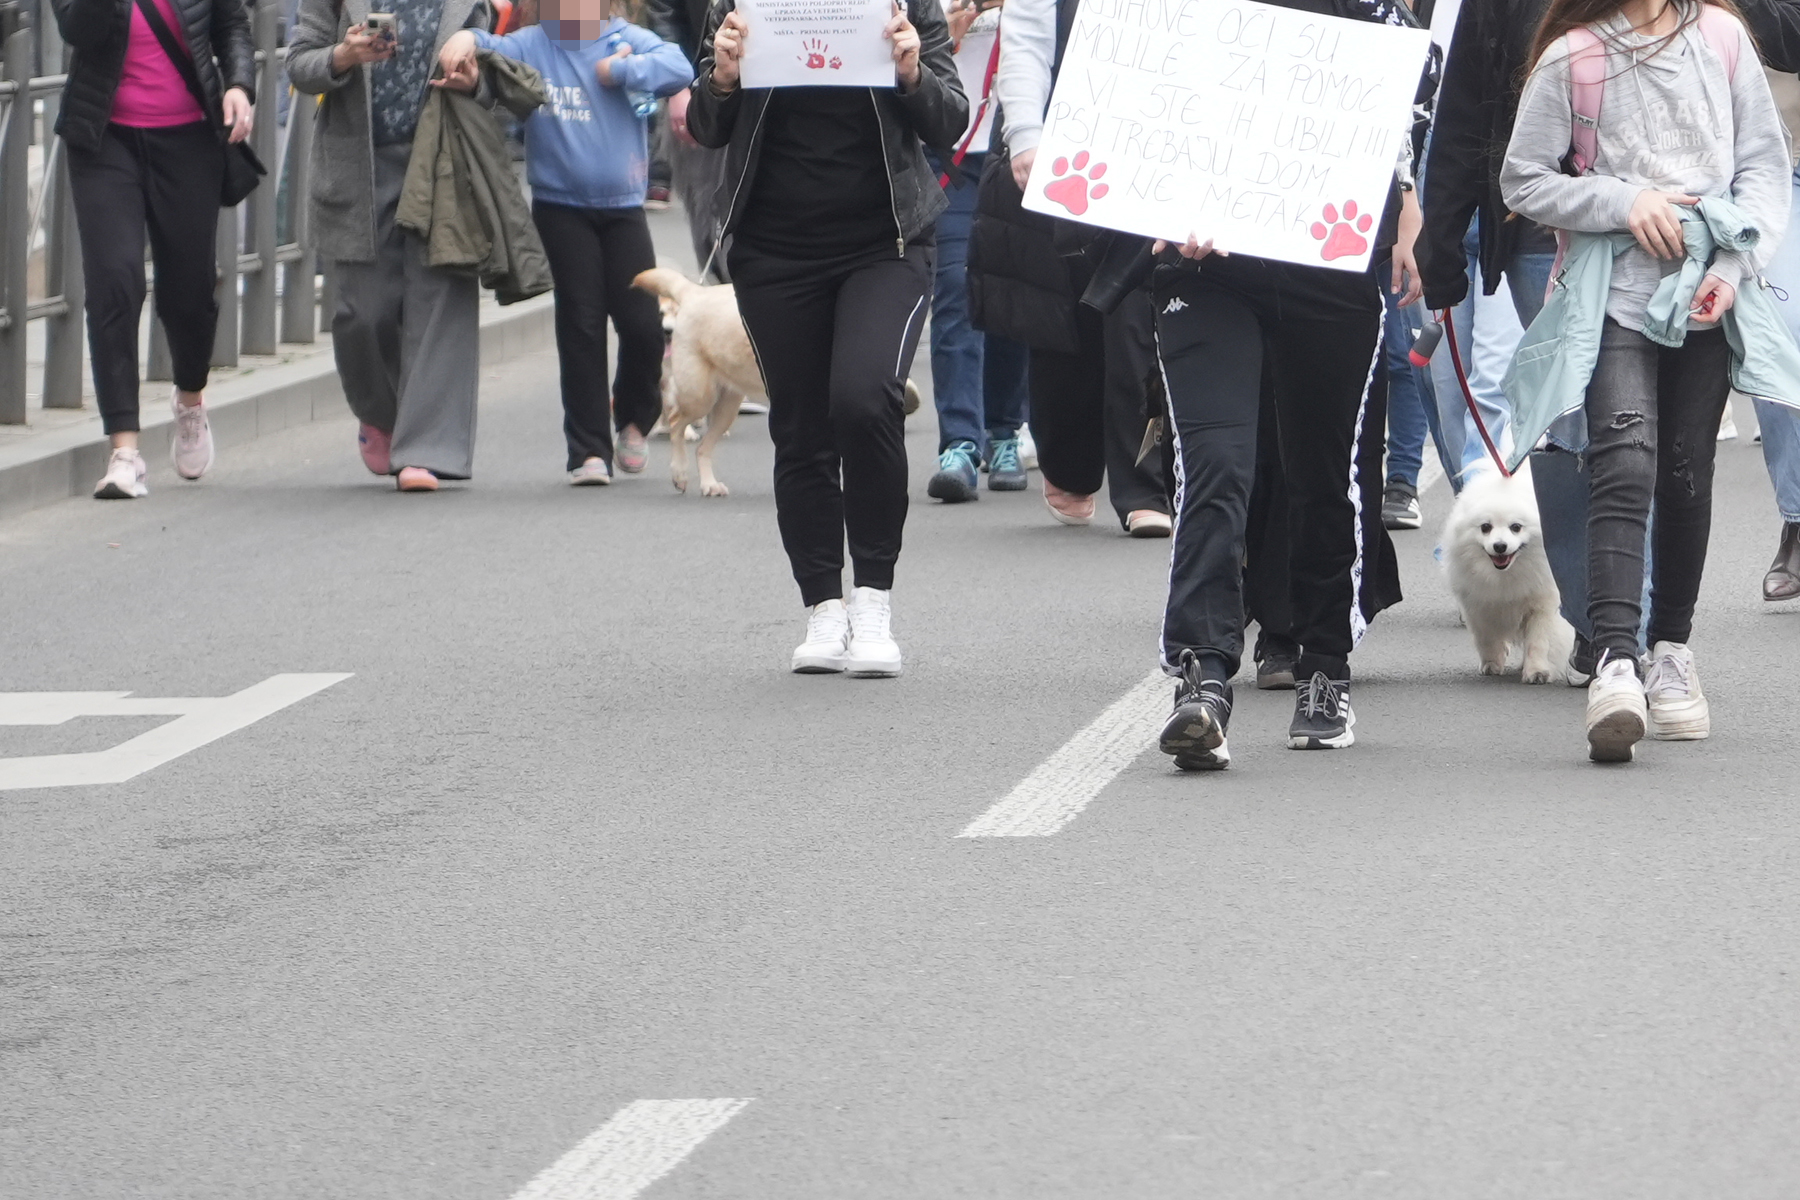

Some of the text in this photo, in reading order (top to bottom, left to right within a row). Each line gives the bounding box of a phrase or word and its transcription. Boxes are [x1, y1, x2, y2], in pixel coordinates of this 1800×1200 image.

[1072, 19, 1384, 112] MOLILE ZA POMOĆ
[1217, 8, 1276, 53] OČI
[1288, 23, 1341, 63] SU
[1051, 101, 1099, 147] PSI
[1111, 115, 1233, 176] TREBAJU
[1086, 68, 1118, 108] VI
[1139, 84, 1201, 124] STE
[1226, 101, 1257, 139] IH
[1126, 165, 1310, 235] NE METAK
